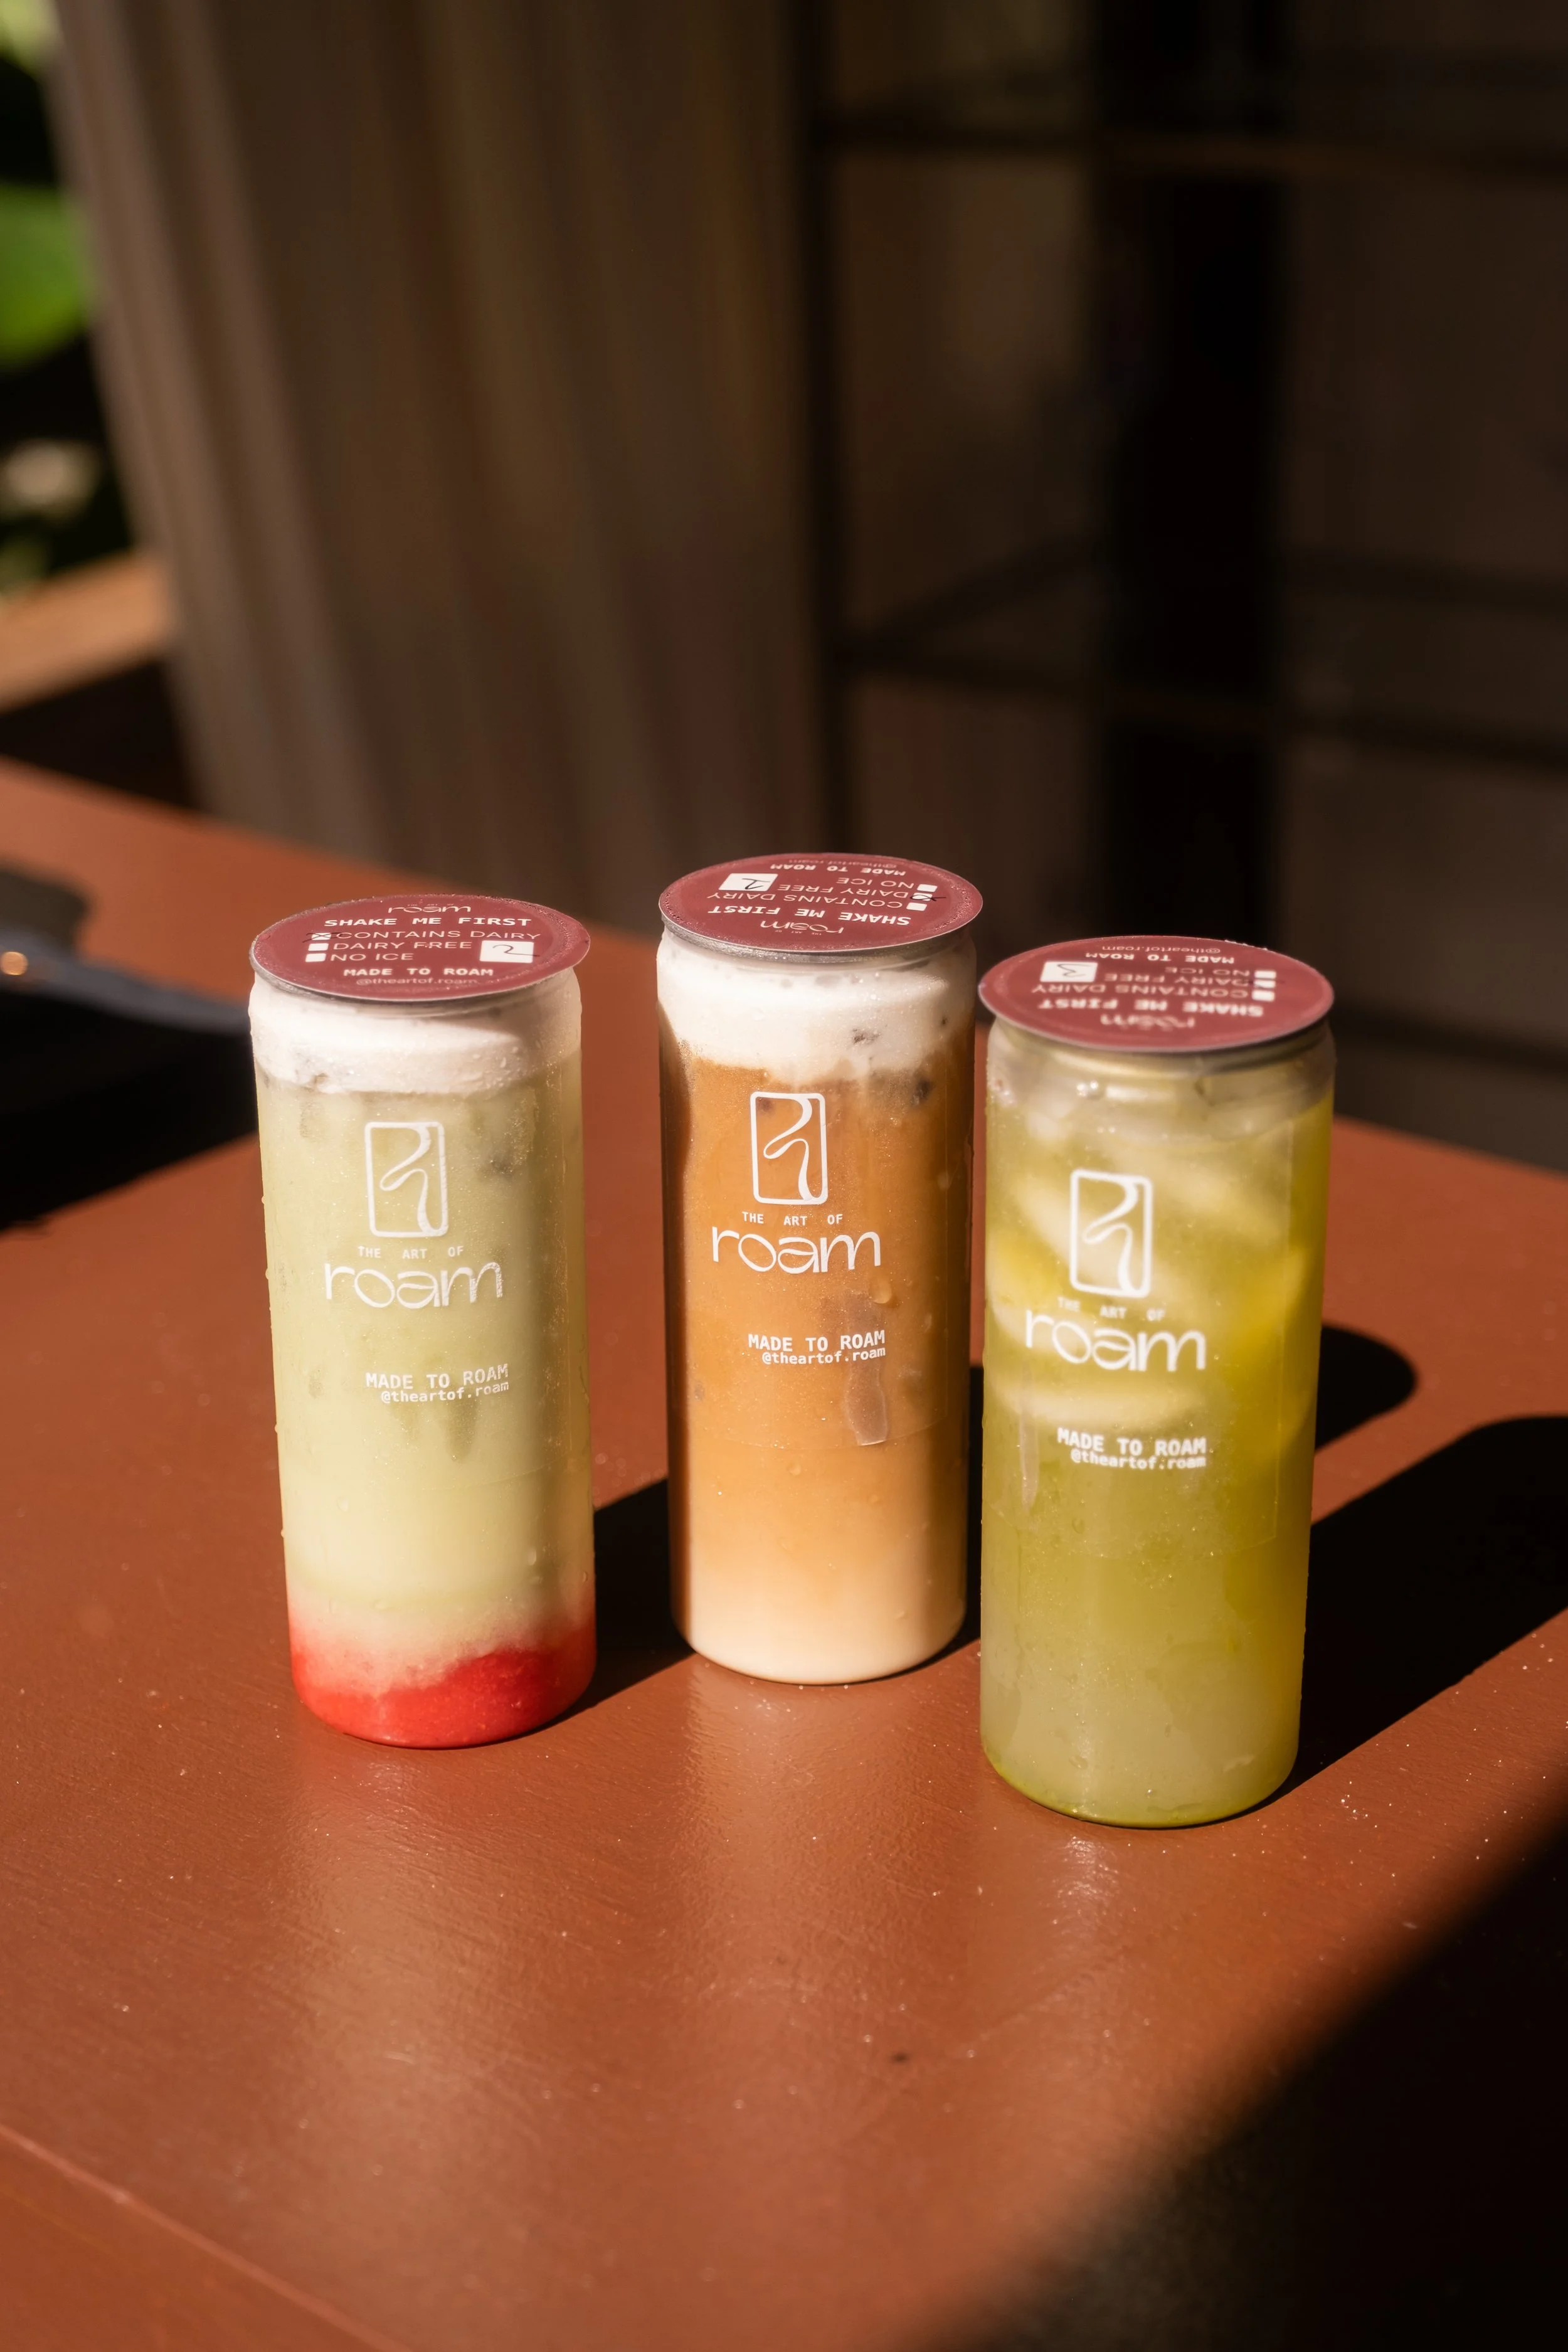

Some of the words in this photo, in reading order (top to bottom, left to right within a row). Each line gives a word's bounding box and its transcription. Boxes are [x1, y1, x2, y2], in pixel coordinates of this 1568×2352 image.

[861, 867, 906, 876] MADE
[879, 881, 914, 889] NO
[707, 893, 776, 901] DAIRY
[840, 889, 908, 898] DAIRY
[783, 896, 902, 908] CONTAINS
[388, 905, 471, 913] roam
[707, 905, 781, 915] FIRST
[794, 908, 824, 918] ME
[324, 918, 398, 926] SHAKE
[458, 918, 532, 926] FIRST
[838, 911, 911, 926] SHAKE
[760, 919, 844, 934] roam
[336, 930, 461, 939] CONTAINS
[470, 931, 541, 940] DAIRY
[492, 944, 540, 957] 2
[1101, 946, 1221, 955] @theartof.roam
[331, 953, 367, 961] NO
[376, 953, 414, 961] ICE
[1185, 956, 1234, 964] MADE
[343, 968, 393, 977] MADE
[444, 968, 494, 977] ROAM
[1103, 973, 1166, 983] FREE
[1031, 982, 1106, 992] DAIRY
[1175, 976, 1249, 987] DAIRY
[1115, 984, 1249, 999] CONTAINS
[1038, 998, 1118, 1010] FIRST
[1134, 999, 1168, 1010] ME
[1182, 1002, 1264, 1017] SHAKE
[742, 1211, 764, 1224] THE
[783, 1216, 807, 1226] ART
[827, 1214, 843, 1224] OF
[358, 1246, 381, 1258] THE
[402, 1248, 426, 1259] ART
[448, 1246, 464, 1257] OF
[711, 1226, 881, 1274] roam
[324, 1261, 503, 1309] roam
[1099, 1305, 1126, 1319] ART
[748, 1333, 793, 1352] MADE
[805, 1337, 828, 1352] TO
[840, 1330, 886, 1350] ROAM
[1025, 1310, 1206, 1372] roam
[762, 1347, 886, 1365] @theartof.roam
[366, 1372, 413, 1389] MADE
[426, 1374, 451, 1389] TO
[463, 1363, 509, 1385] ROAM
[381, 1381, 509, 1404] @theartof.roam
[1057, 1427, 1104, 1452] MADE
[1116, 1438, 1142, 1455] TO
[1155, 1437, 1206, 1456] ROAM
[1070, 1449, 1206, 1470] @theartof.roam
